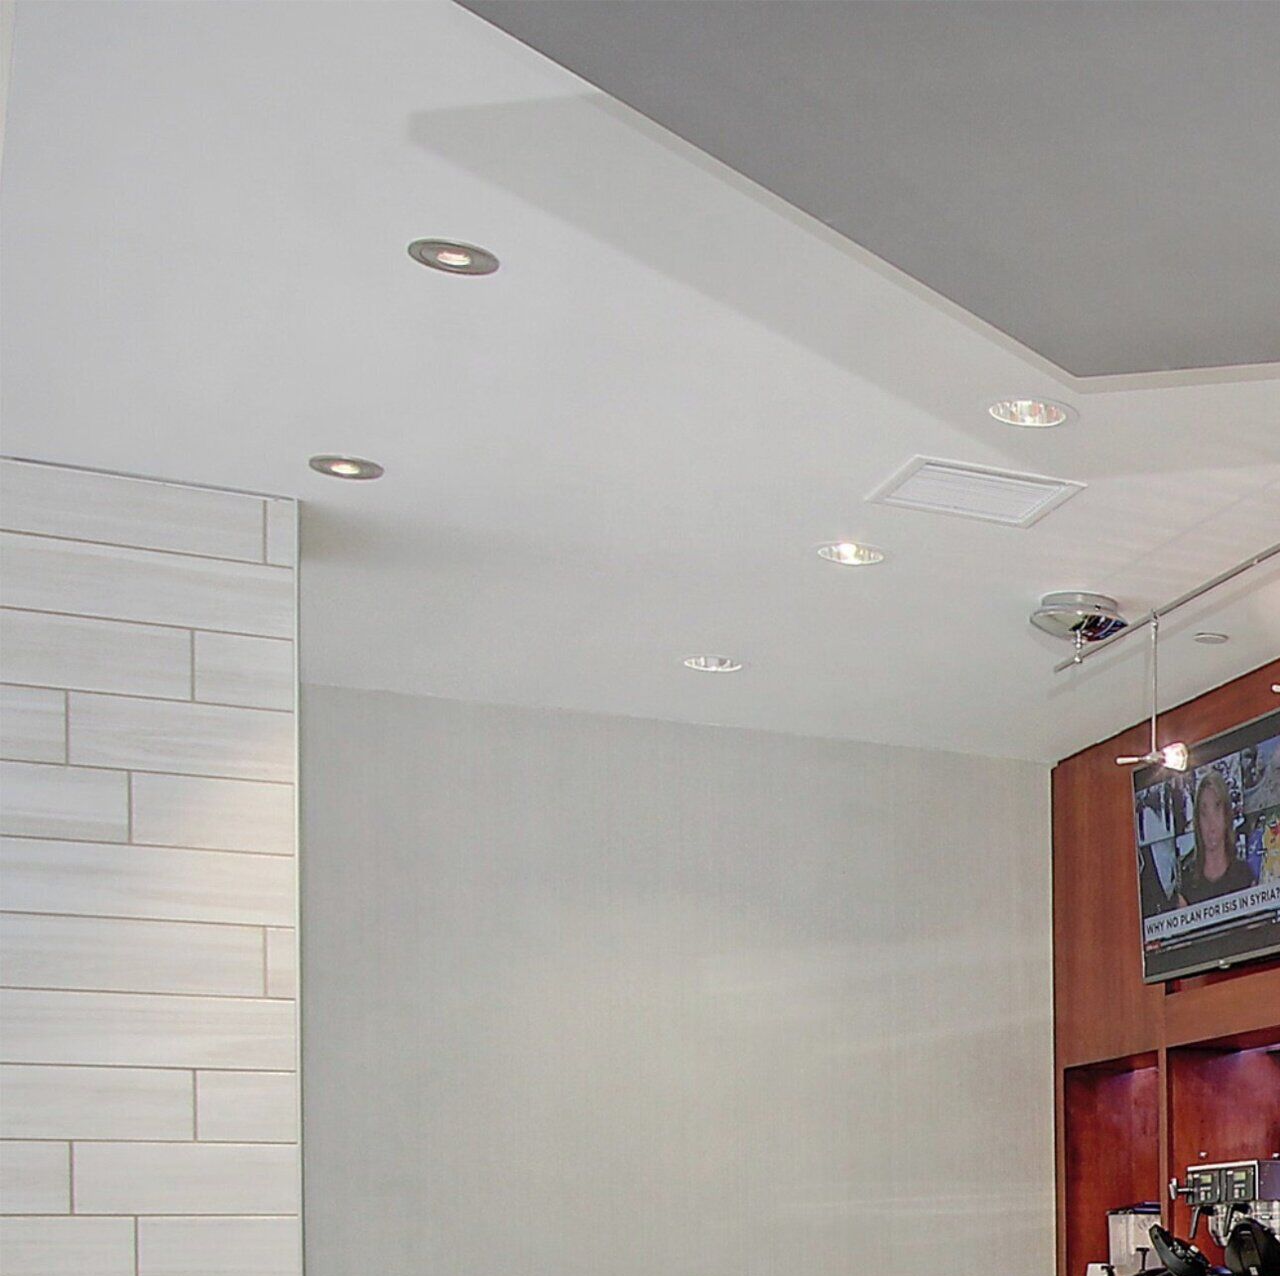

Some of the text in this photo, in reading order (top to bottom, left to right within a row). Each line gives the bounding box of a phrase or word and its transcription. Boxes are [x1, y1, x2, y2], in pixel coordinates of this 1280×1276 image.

[1146, 919, 1164, 935] WHY
[1166, 916, 1179, 930] NO
[1180, 910, 1201, 926] PLAN
[1203, 905, 1221, 922] FOR
[1221, 901, 1237, 917] ISIS
[1239, 897, 1250, 911] IN
[1250, 886, 1280, 906] SYRIA?
